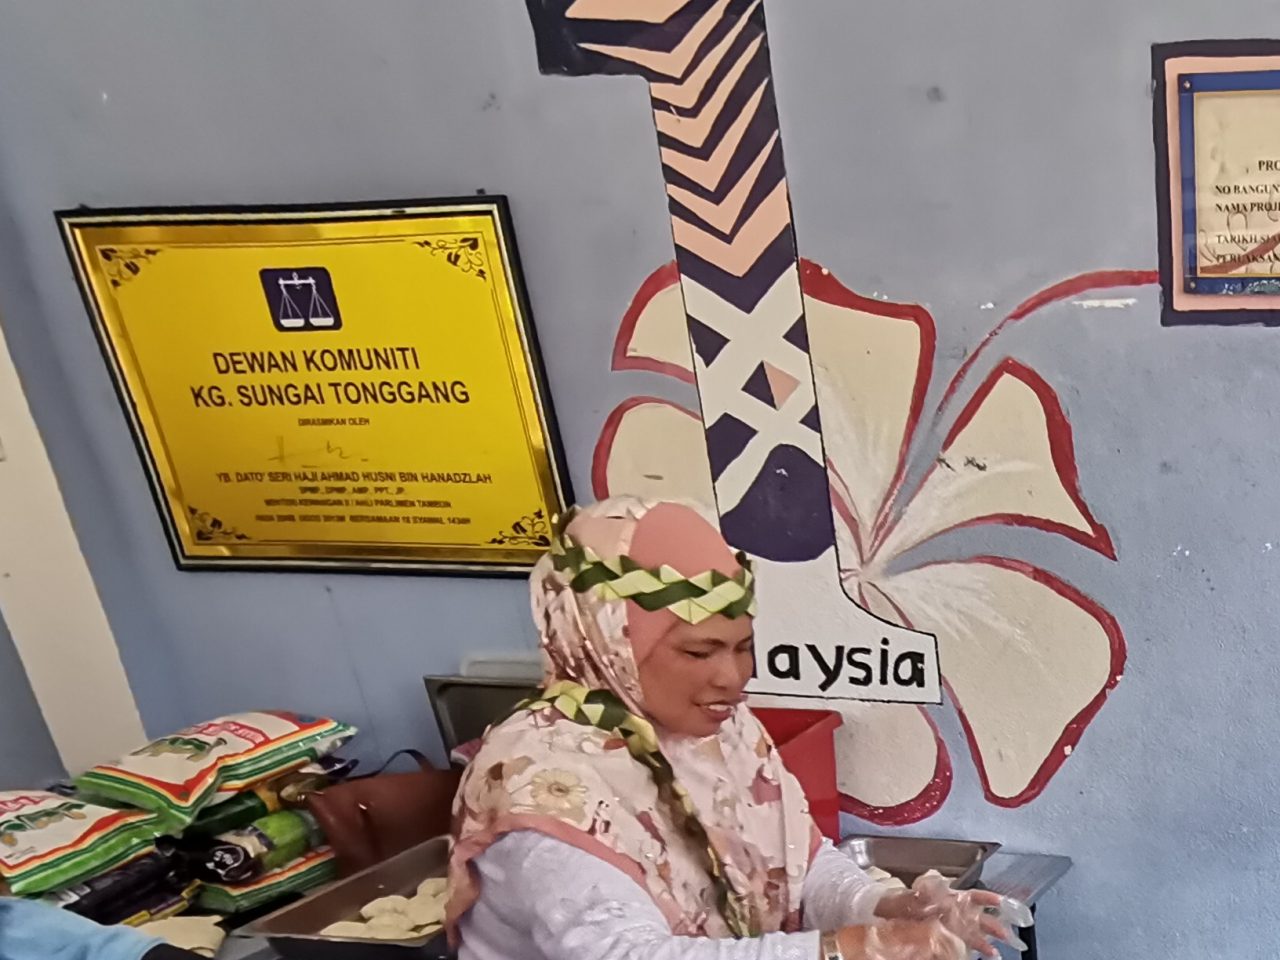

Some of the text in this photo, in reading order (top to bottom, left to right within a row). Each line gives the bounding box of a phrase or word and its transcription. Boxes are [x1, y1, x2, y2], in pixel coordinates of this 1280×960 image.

[1215, 185, 1231, 195] NO
[1216, 203, 1248, 212] NAMA
[213, 347, 420, 375] DEWAN KOMUNITI
[190, 381, 470, 408] KG. SUNGAI TONGGANG
[268, 471, 292, 482] SERI
[294, 472, 317, 482] HAJI
[320, 471, 359, 482] AHMAD
[362, 472, 396, 482] HUSNI
[398, 472, 418, 482] BIN
[421, 472, 492, 483] HANADZLAH
[767, 637, 926, 692] aysia
